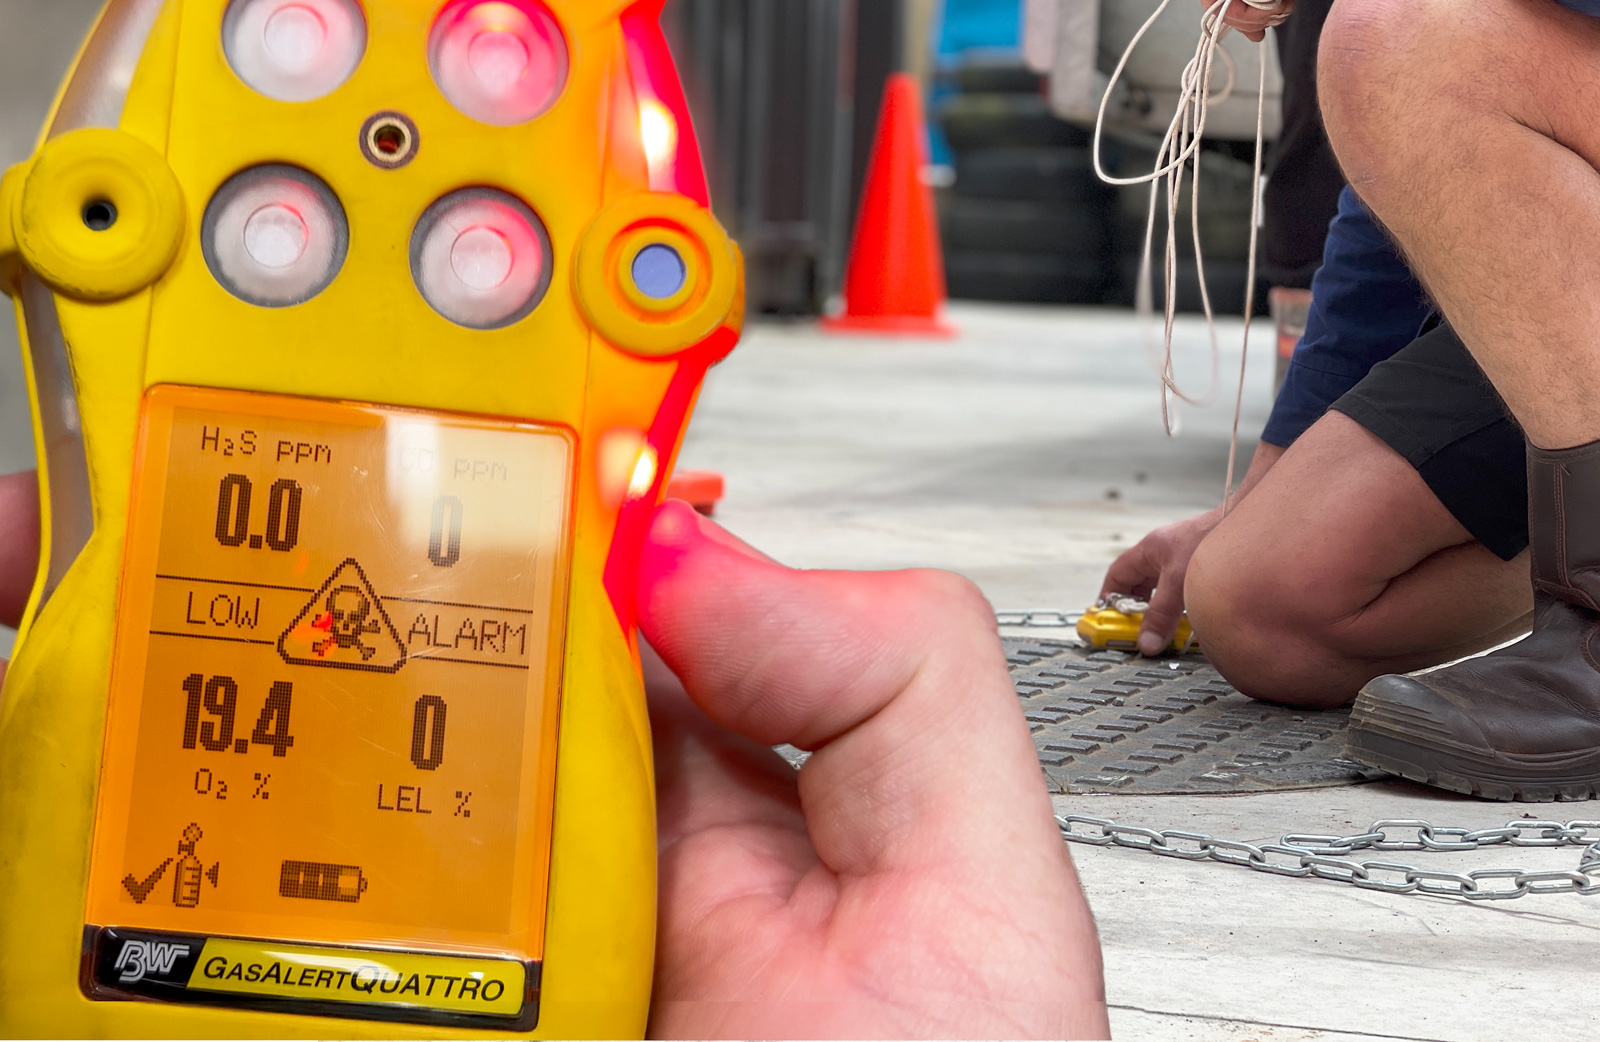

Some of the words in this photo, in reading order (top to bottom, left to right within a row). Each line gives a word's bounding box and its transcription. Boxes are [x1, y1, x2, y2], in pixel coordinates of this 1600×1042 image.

[214, 473, 302, 552] 0.0
[427, 494, 463, 568] 0
[186, 591, 260, 629] LOW
[408, 613, 527, 655] ALARM
[181, 673, 294, 757] 19.4
[411, 694, 448, 771] 0
[377, 783, 432, 814] LEL
[114, 939, 190, 983] BW
